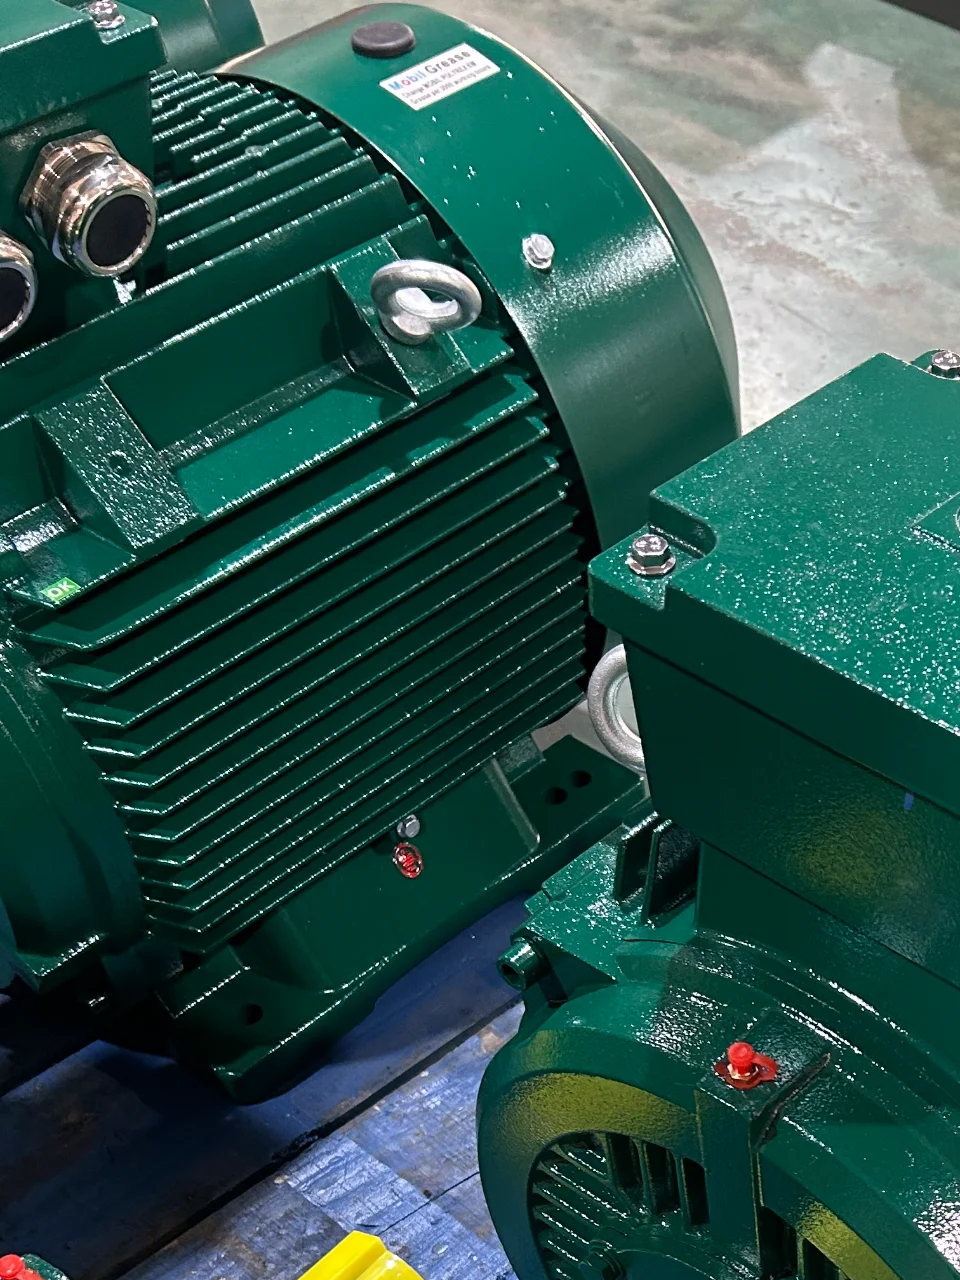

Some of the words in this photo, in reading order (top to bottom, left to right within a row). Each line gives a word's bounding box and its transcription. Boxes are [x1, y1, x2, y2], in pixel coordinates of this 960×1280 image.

[388, 71, 426, 91] Mobil
[424, 50, 472, 74] Grease
[47, 580, 76, 599] OK
